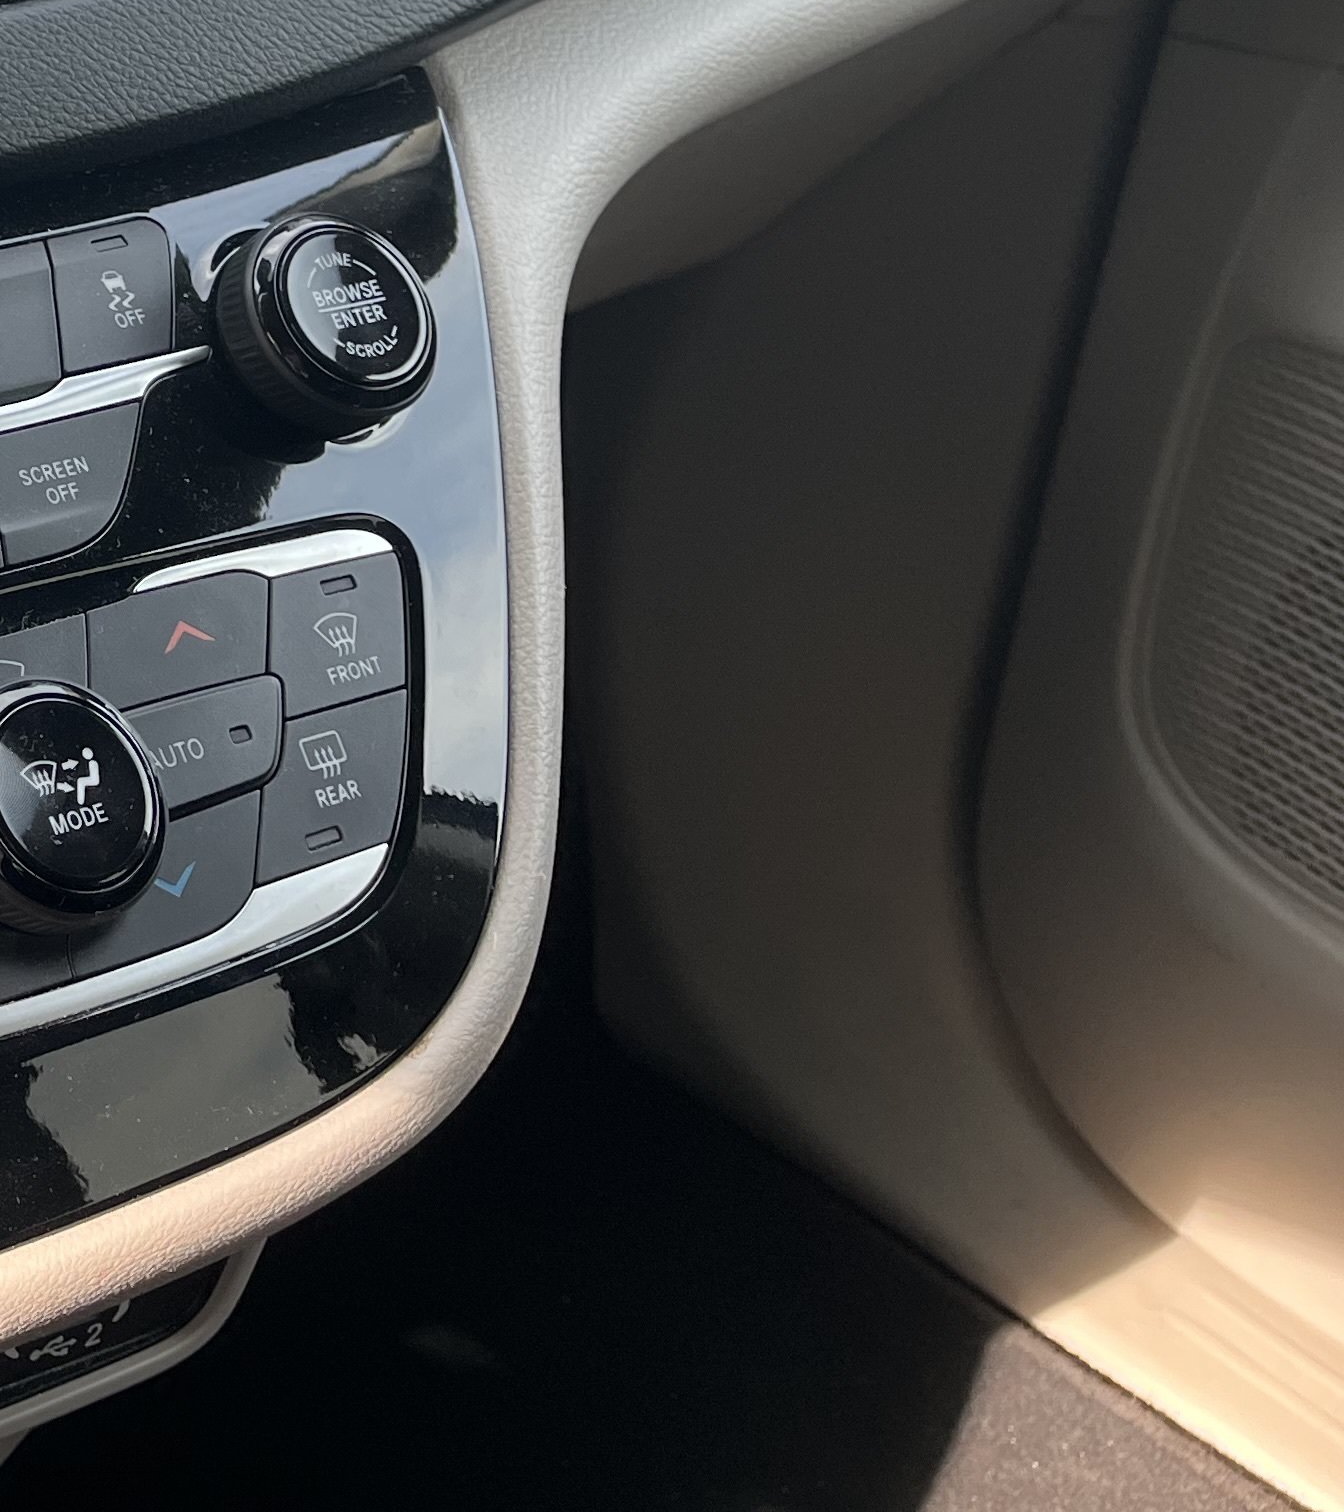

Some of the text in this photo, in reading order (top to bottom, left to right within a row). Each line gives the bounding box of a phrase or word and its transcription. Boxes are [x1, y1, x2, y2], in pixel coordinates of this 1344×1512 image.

[315, 252, 352, 270] TUNE
[312, 279, 383, 307] BROWSE
[114, 307, 147, 329] OFF
[330, 304, 387, 330] ENTER
[345, 334, 399, 358] SCROLL
[18, 456, 90, 487] SCREEN
[45, 482, 80, 506] OFF
[326, 657, 381, 686] FRONT
[315, 780, 362, 808] REAR
[48, 802, 109, 836] MODE
